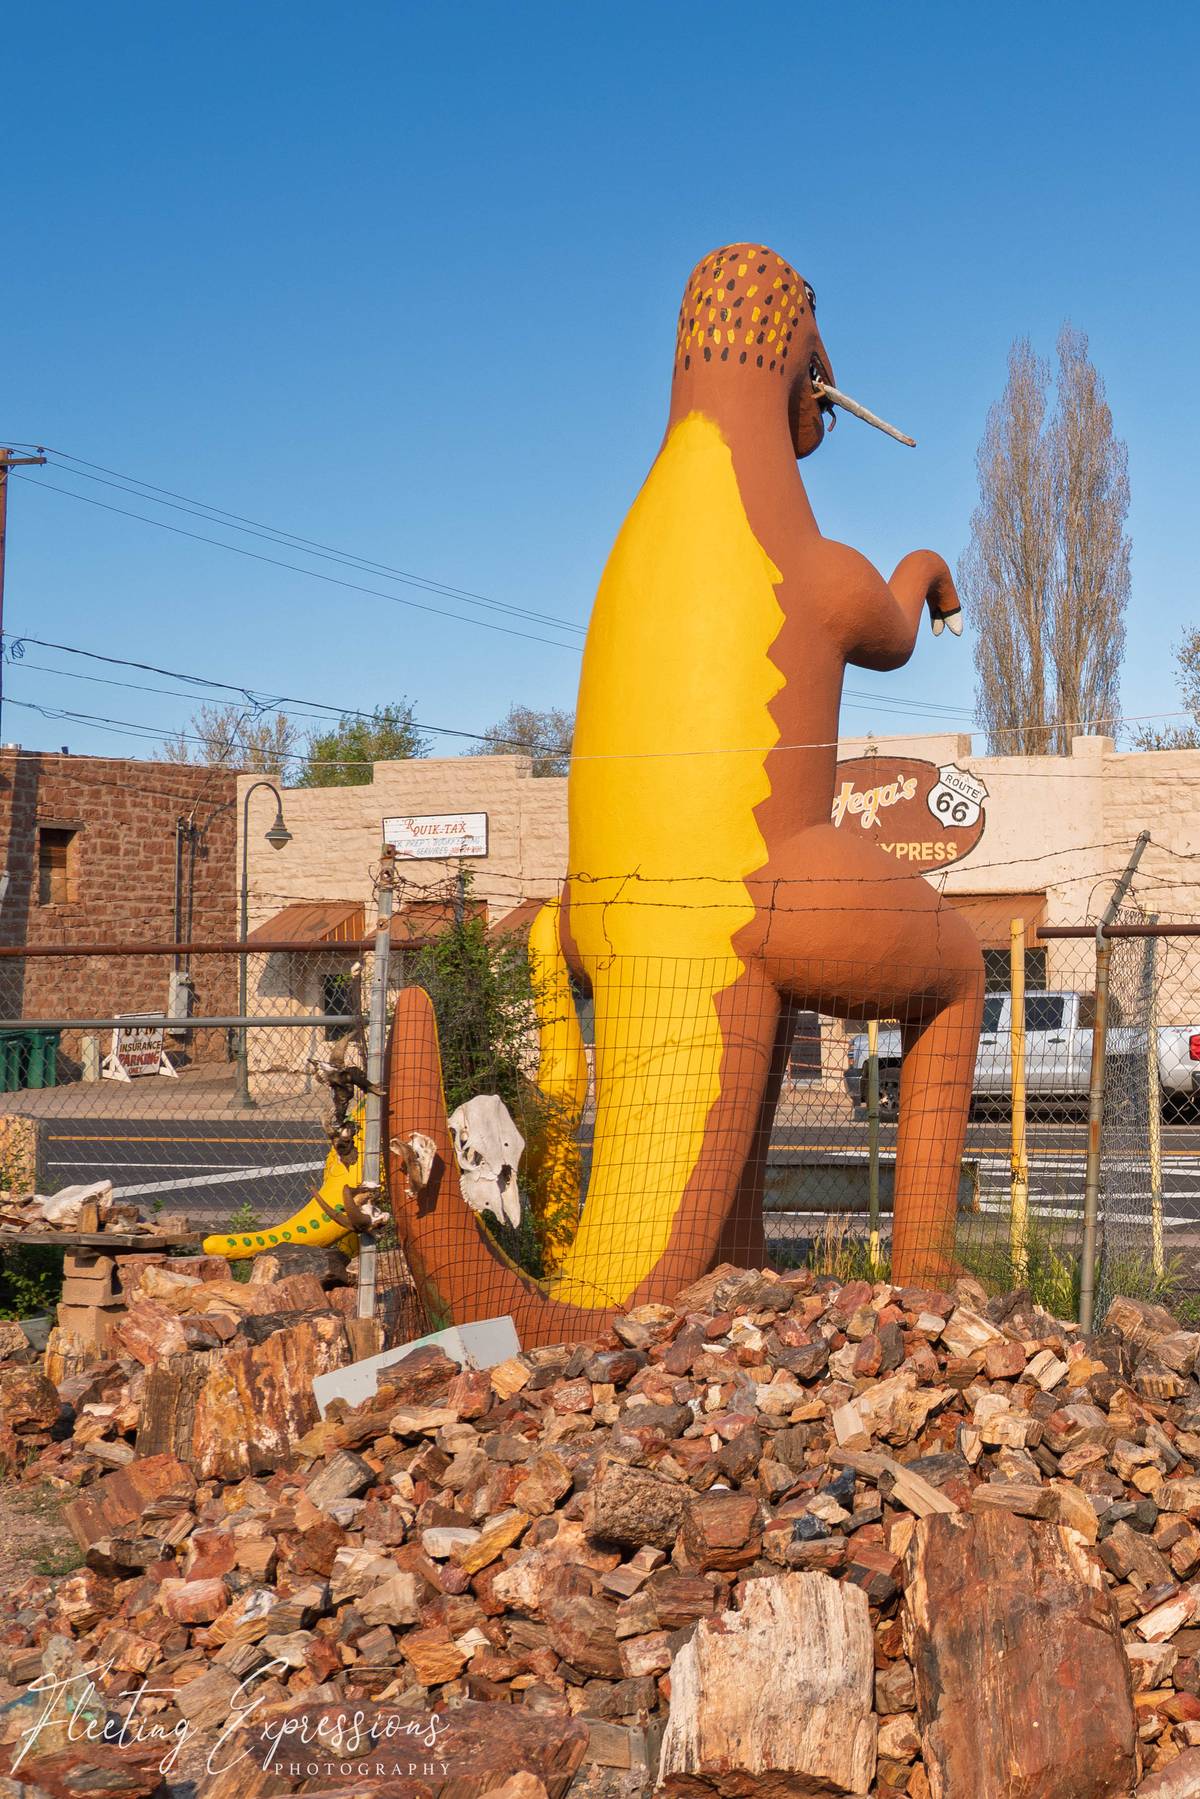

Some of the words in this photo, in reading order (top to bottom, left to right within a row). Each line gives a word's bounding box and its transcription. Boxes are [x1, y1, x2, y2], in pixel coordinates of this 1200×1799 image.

[945, 774, 980, 799] ROUTE
[936, 791, 969, 823] 66
[120, 1041, 161, 1052] INSURANCE
[119, 1053, 159, 1066] PARKING
